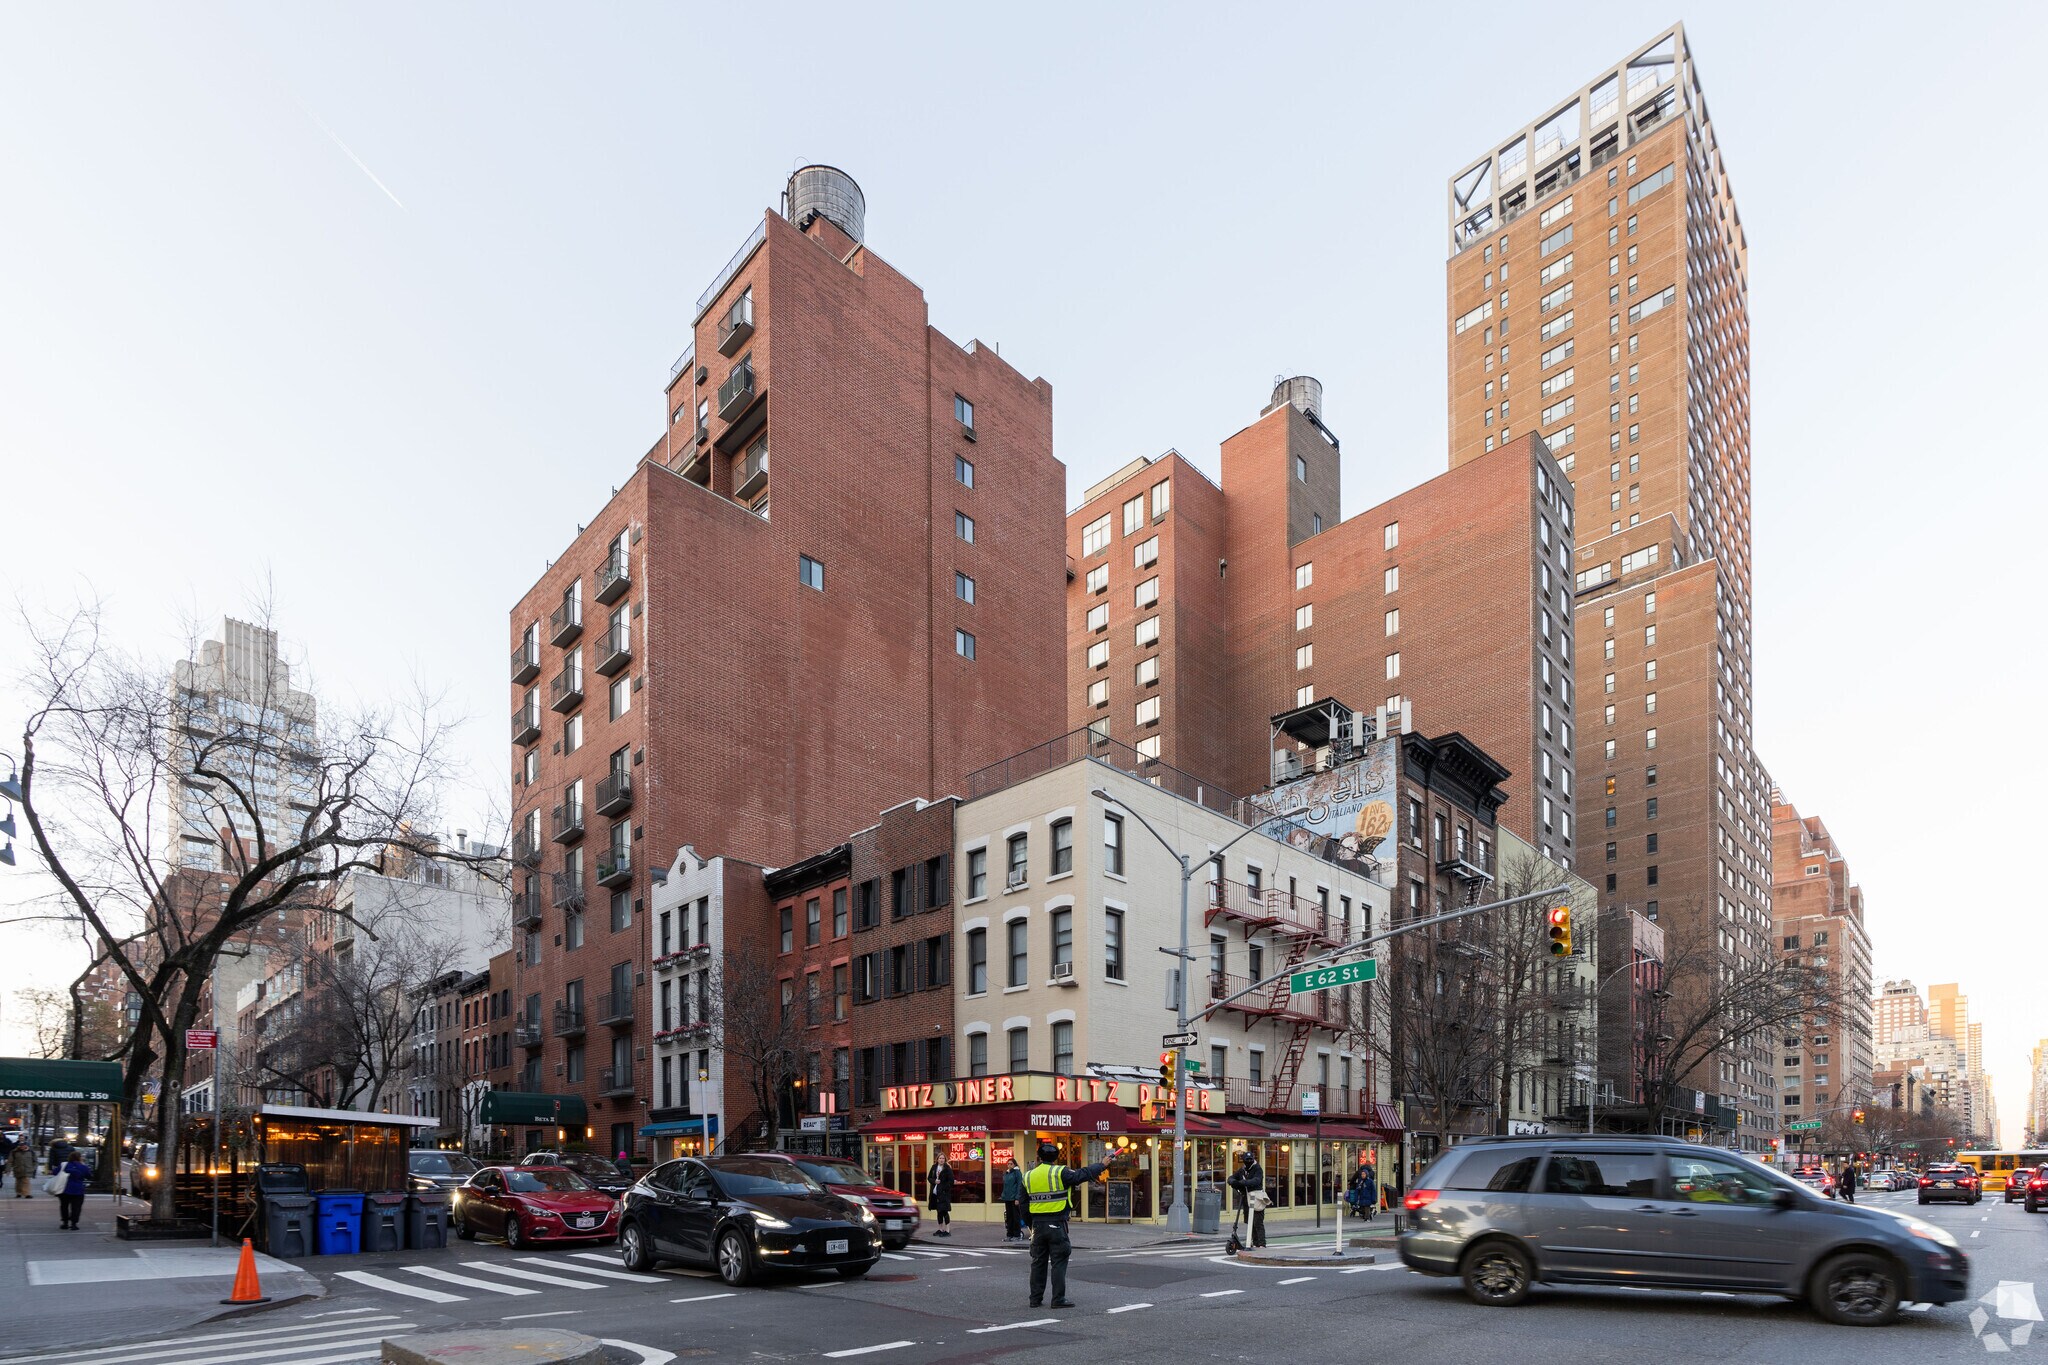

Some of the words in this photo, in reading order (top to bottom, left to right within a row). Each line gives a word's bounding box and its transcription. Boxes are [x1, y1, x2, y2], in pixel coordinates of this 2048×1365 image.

[1328, 803, 1362, 820] ITALIANO
[1361, 805, 1369, 832] 1
[1370, 802, 1386, 815] AVE
[1366, 814, 1386, 837] 62
[1305, 975, 1313, 988] E
[1318, 971, 1336, 985] 62
[1342, 966, 1359, 980] St
[6, 1089, 84, 1099] CONDOMINIUM
[90, 1092, 109, 1100] 350
[887, 1083, 933, 1109] RITZ
[944, 1075, 1014, 1105] DINER
[1055, 1076, 1119, 1103] RITZ
[1138, 1083, 1210, 1111] DINER
[1031, 1113, 1048, 1126] RITZ
[1049, 1114, 1072, 1127] DINER
[1096, 1120, 1110, 1131] 1133
[951, 1143, 965, 1152] HOT
[992, 1149, 1013, 1157] OPEN
[949, 1151, 968, 1161] SOUP
